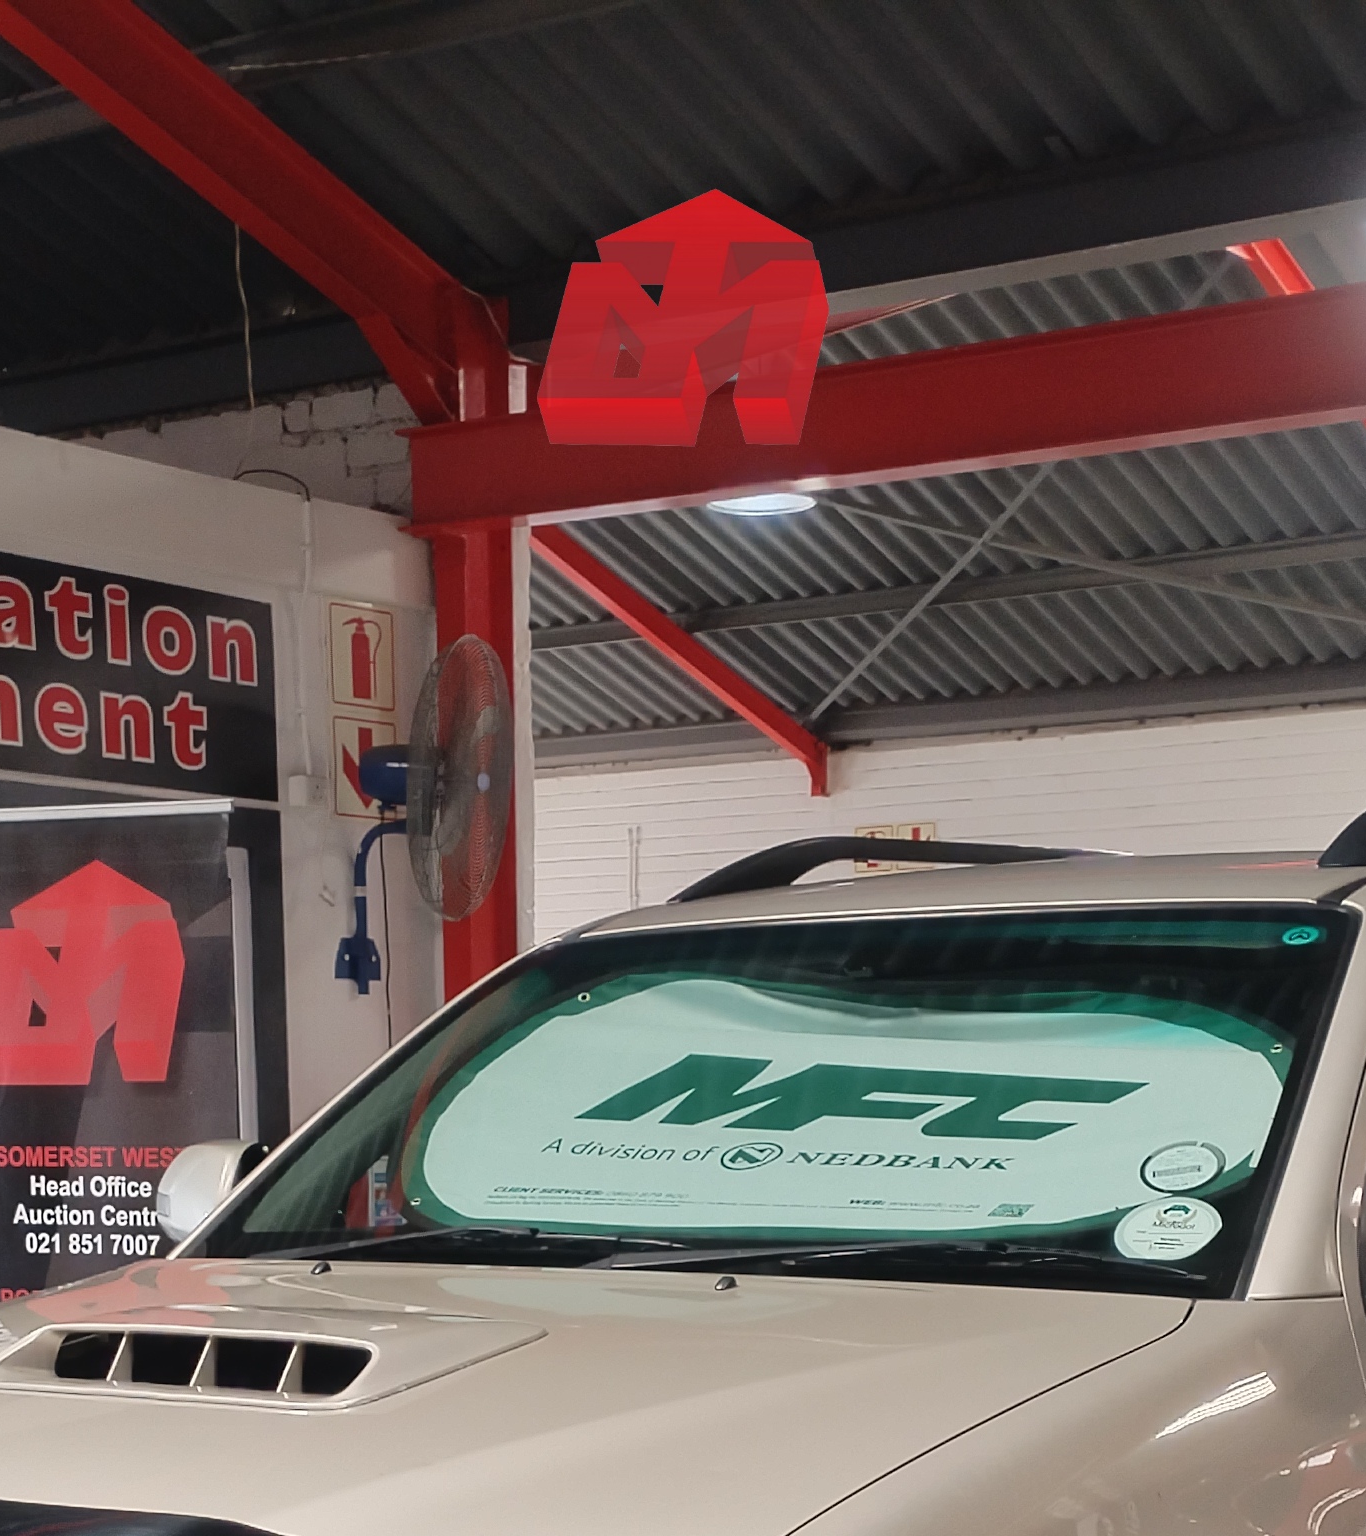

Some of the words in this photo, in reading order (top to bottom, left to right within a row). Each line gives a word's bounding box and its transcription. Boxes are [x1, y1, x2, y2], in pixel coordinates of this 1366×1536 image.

[541, 1138, 563, 1153] A
[571, 1141, 676, 1161] division
[682, 1146, 720, 1161] of
[786, 1152, 1015, 1171] NEDBANK
[29, 1175, 84, 1197] Head
[89, 1176, 152, 1198] Office
[13, 1203, 95, 1225] Auction
[100, 1204, 158, 1227] Centr
[25, 1232, 61, 1254] 021
[68, 1233, 103, 1255] 851
[110, 1234, 160, 1256] 7007
